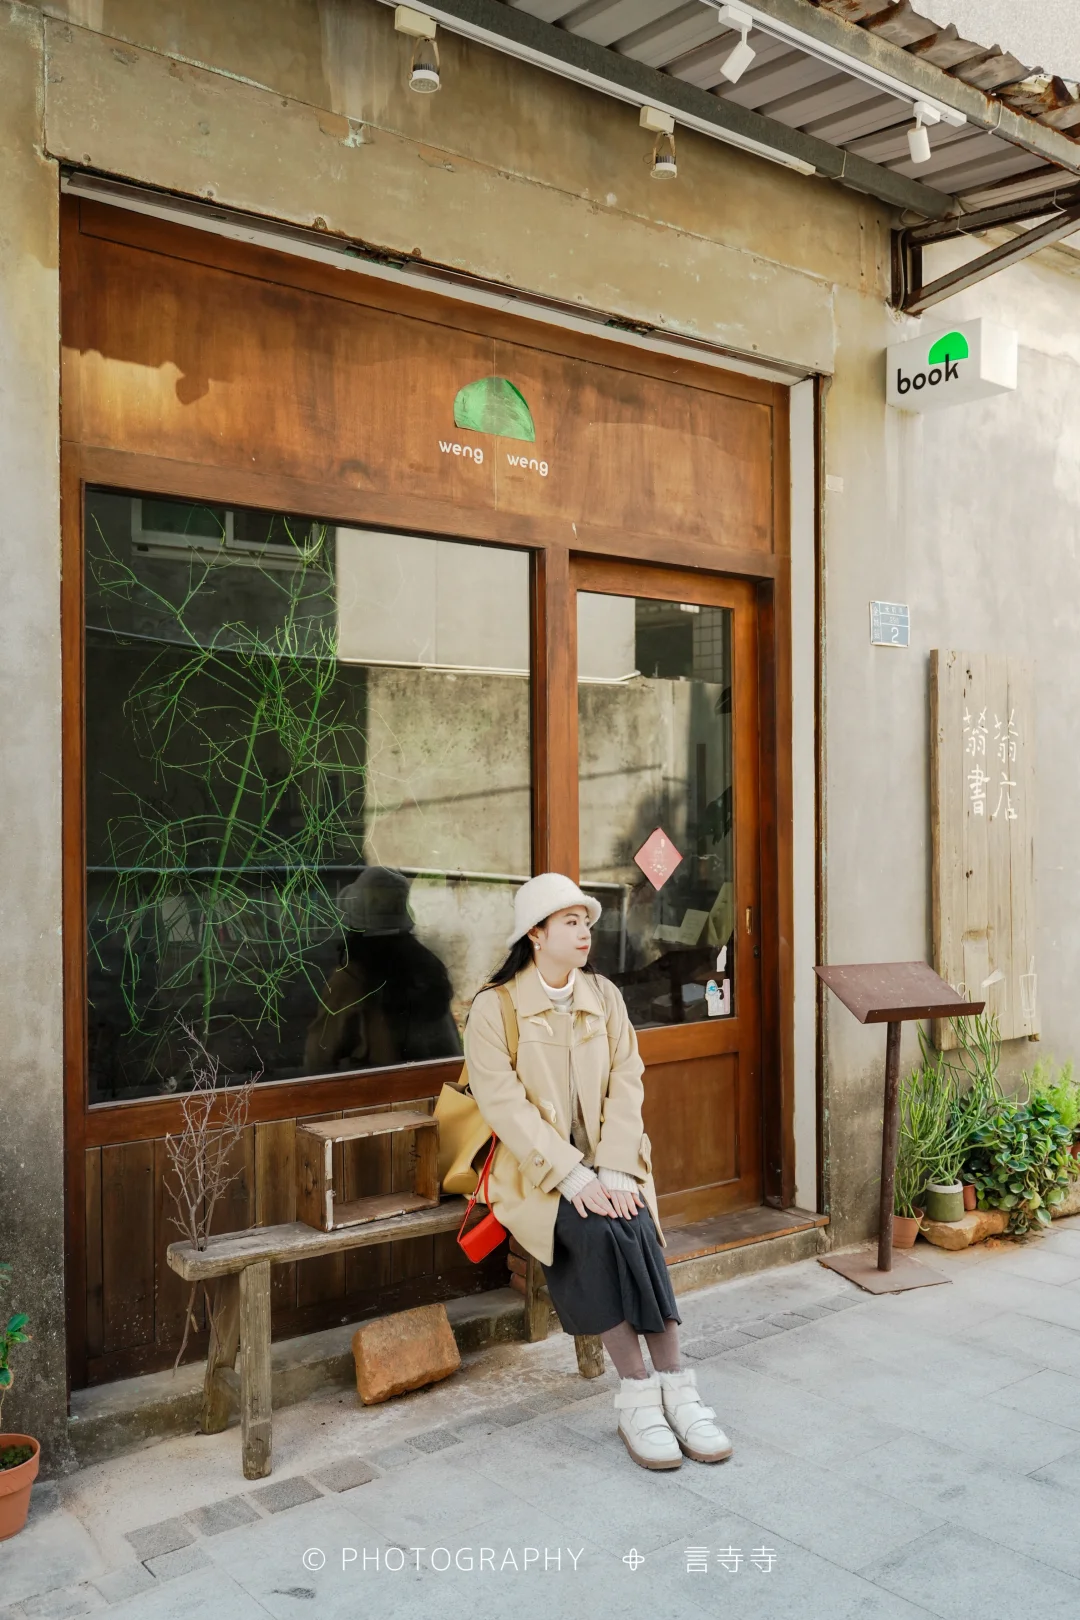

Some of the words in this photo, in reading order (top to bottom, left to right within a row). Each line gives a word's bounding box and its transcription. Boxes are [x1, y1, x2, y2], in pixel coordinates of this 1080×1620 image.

[897, 353, 959, 395] book
[438, 440, 484, 465] weng
[506, 453, 549, 477] weng
[891, 626, 900, 644] 2
[967, 763, 1019, 821] 書店
